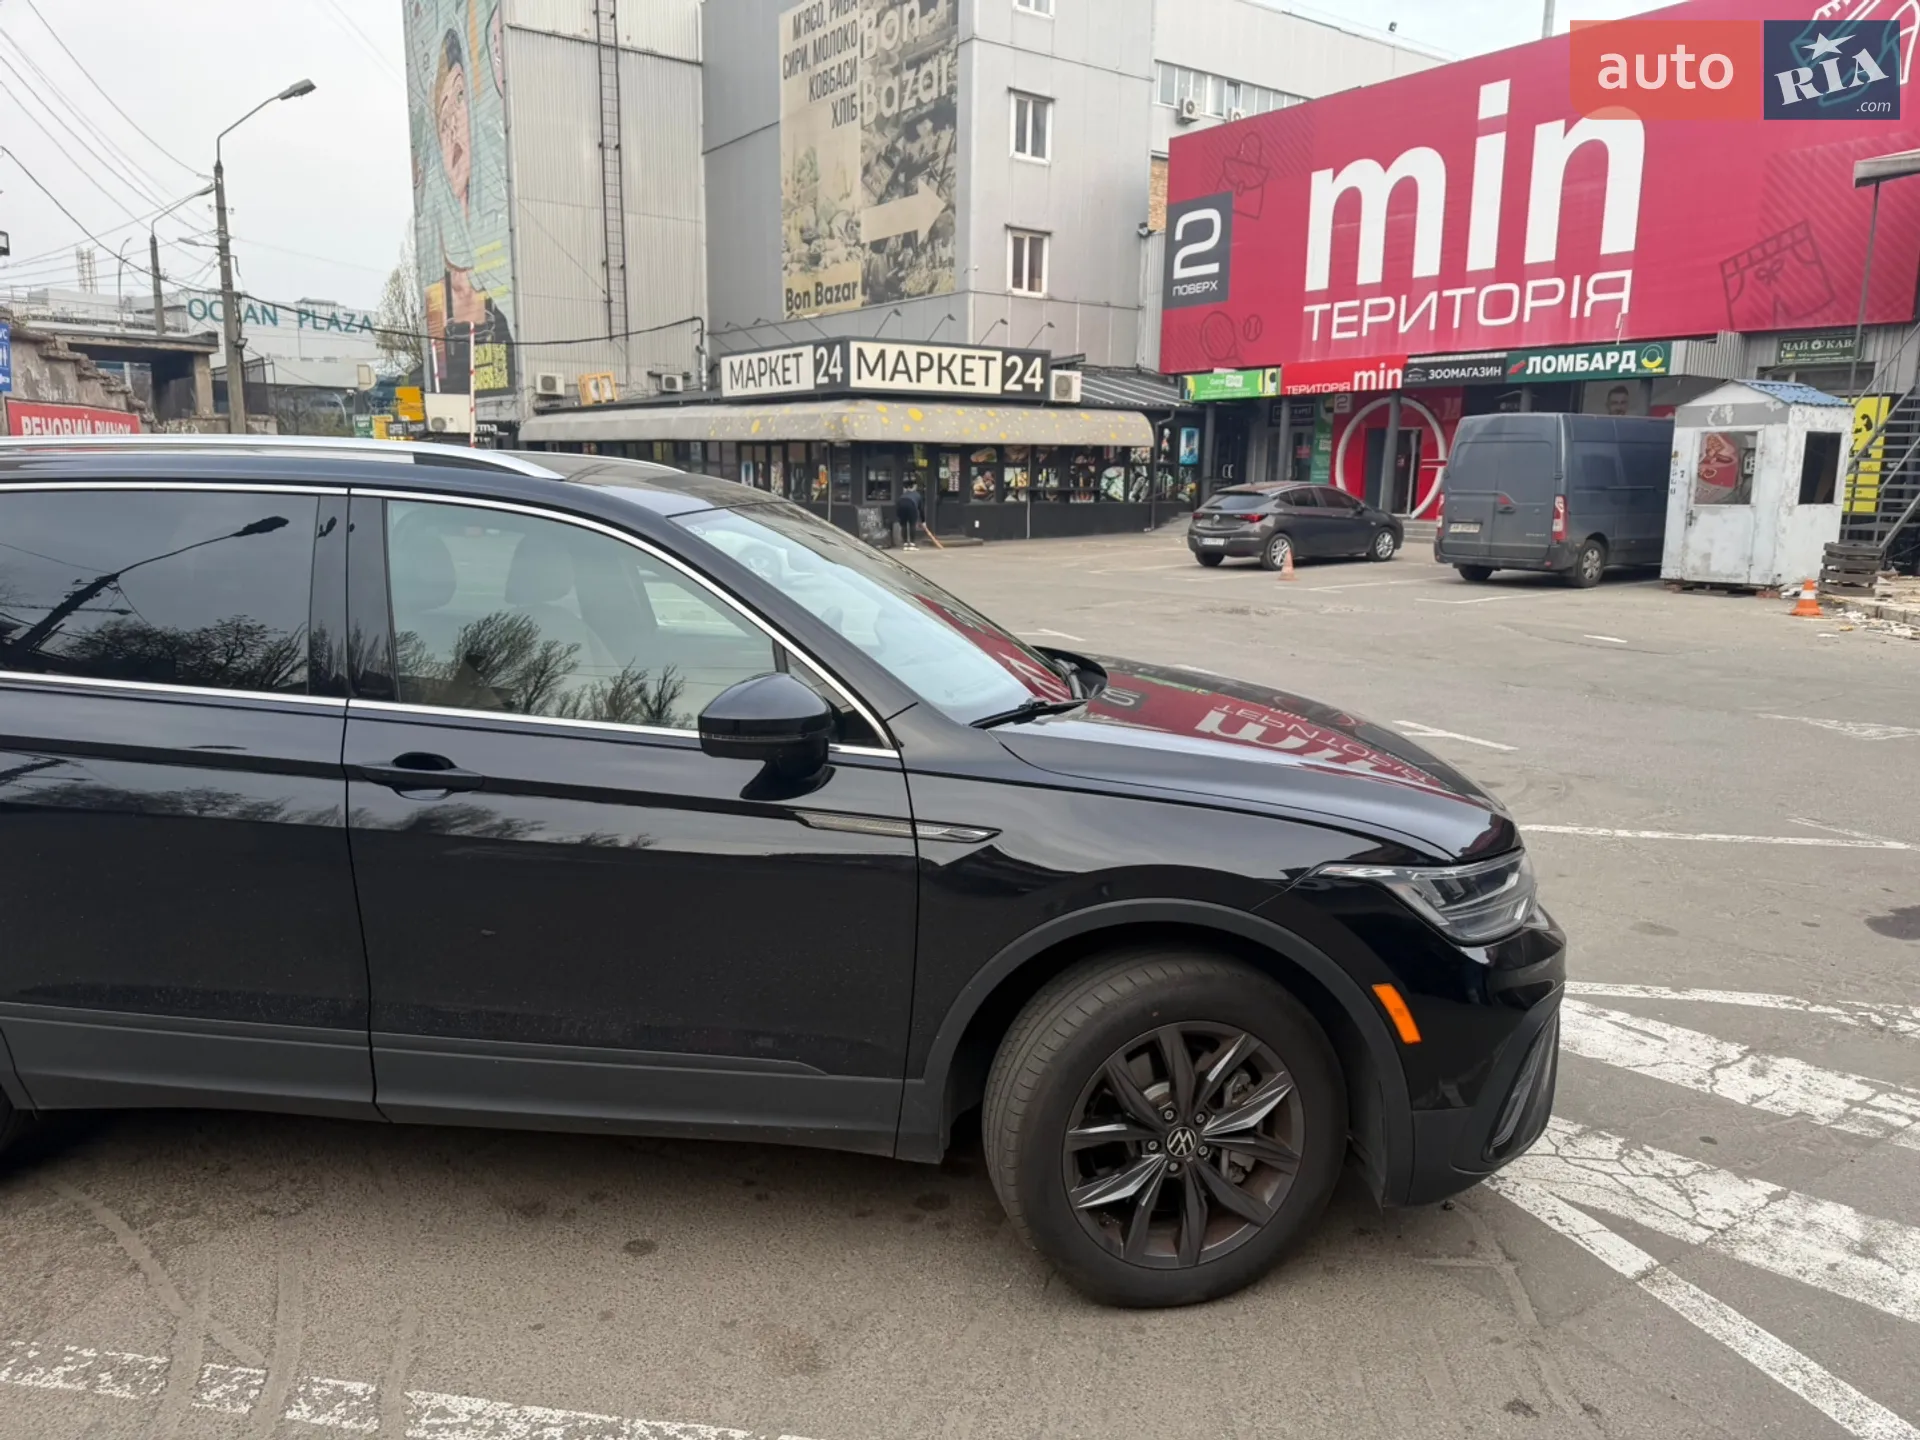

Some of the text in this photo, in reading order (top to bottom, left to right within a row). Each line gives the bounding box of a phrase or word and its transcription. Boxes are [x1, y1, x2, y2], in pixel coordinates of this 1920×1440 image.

[782, 19, 857, 80] СИРИ, МОЛОКО
[862, 0, 920, 61] Bon
[808, 56, 857, 103] КОВБАСИ
[862, 51, 955, 130] Bazar
[830, 92, 857, 129] ХЛІБ
[1304, 78, 1646, 293] min
[1172, 207, 1223, 280] 2
[785, 281, 858, 312] Bon Bazar
[1172, 279, 1219, 297] ПОВЕРХ
[1303, 268, 1633, 342] ТЕРИТОРІЯ
[187, 298, 376, 335] OCAN PLAZA
[729, 344, 843, 390] МАРКЕТ 24
[856, 347, 1045, 392] МАРКЕТ 24
[1353, 362, 1403, 391] min
[1428, 366, 1502, 379] ЗООМАГАЗИН
[1526, 350, 1637, 375] ЛОМБАРД
[1286, 382, 1351, 395] ТЕРИТОРІЯ
